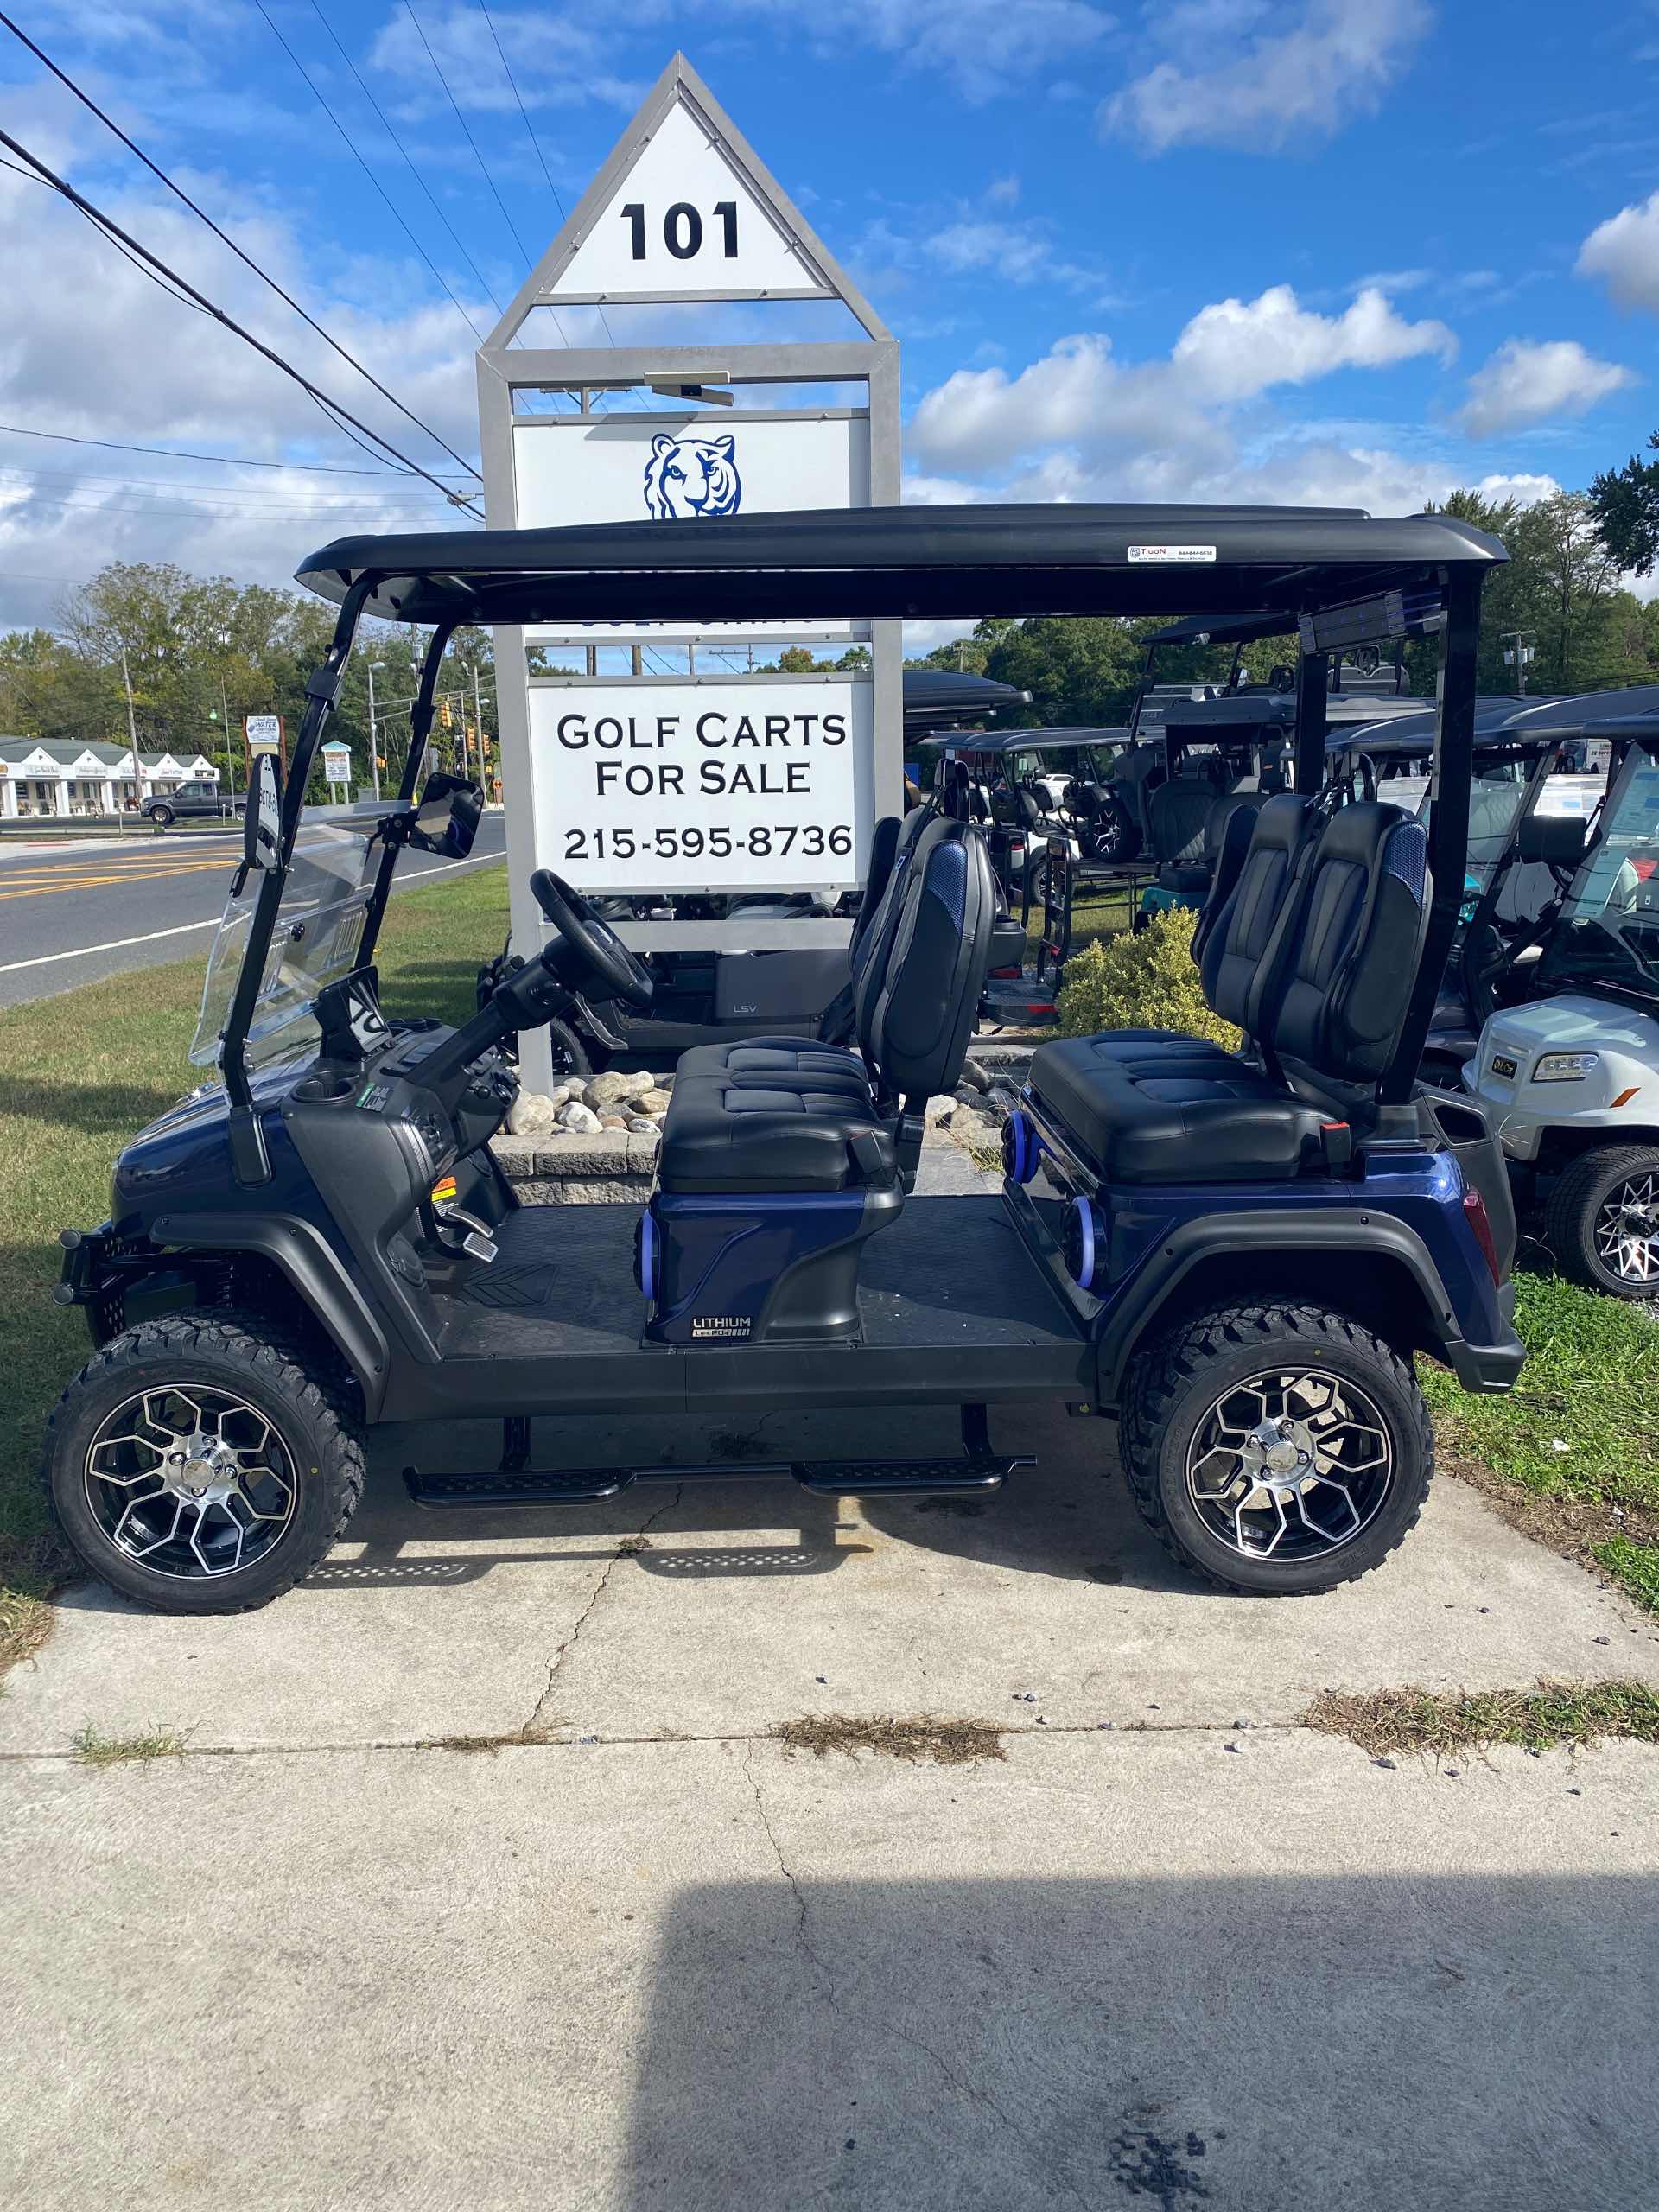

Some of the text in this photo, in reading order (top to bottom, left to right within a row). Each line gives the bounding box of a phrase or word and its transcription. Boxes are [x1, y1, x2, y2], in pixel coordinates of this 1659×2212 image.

[620, 201, 739, 261] 101
[557, 712, 847, 750] GOLF CARTS
[595, 760, 812, 796] FOR SALE
[564, 824, 853, 860] 215-595-8736
[733, 1004, 757, 1013] LSV
[693, 1317, 751, 1328] LITHIUM
